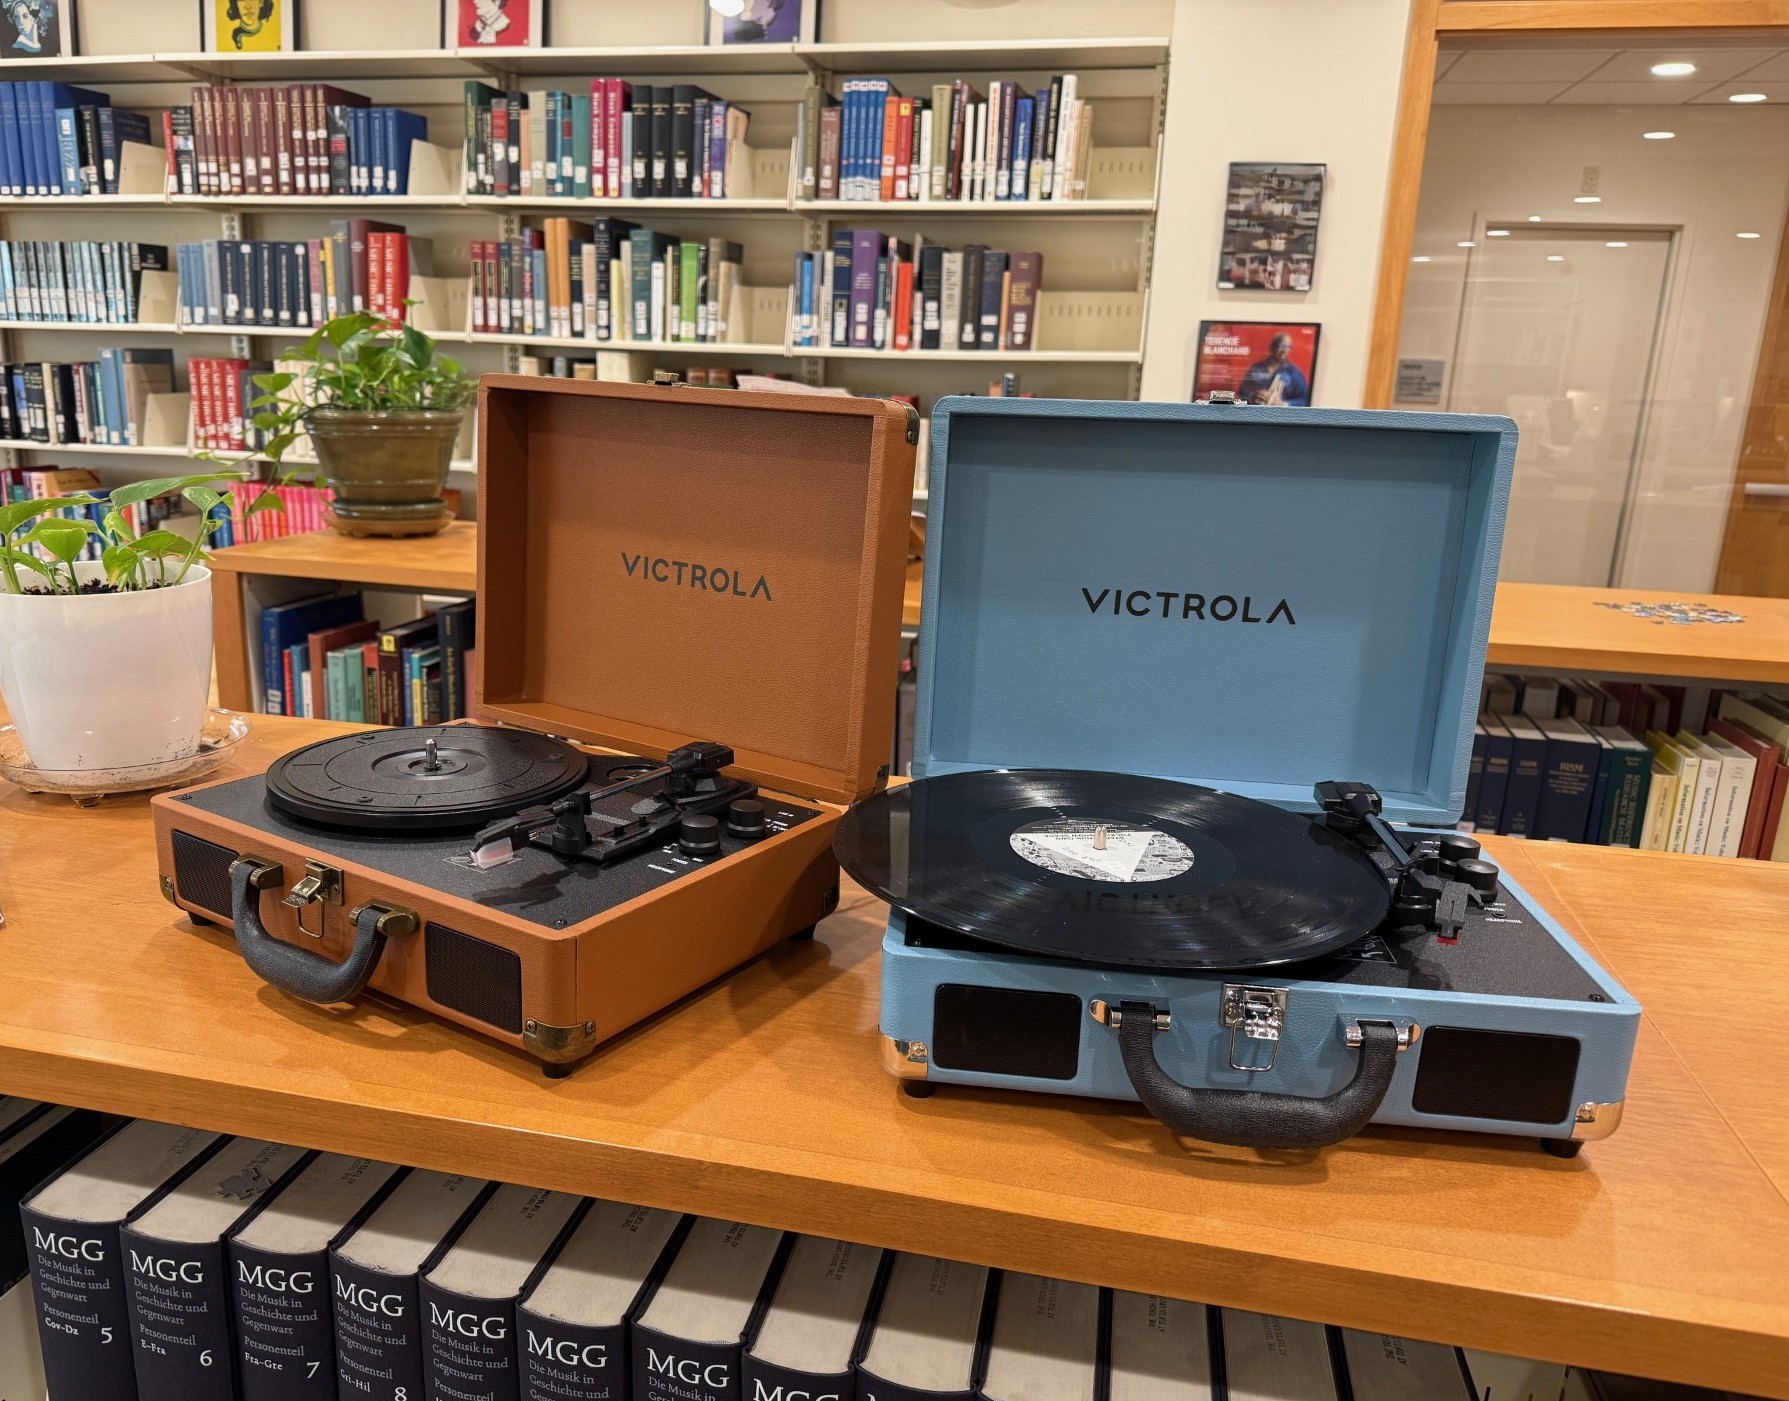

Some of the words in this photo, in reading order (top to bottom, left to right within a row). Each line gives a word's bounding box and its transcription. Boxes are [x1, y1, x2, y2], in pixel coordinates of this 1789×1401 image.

[1202, 345, 1250, 356] BLANCHARD
[1203, 335, 1240, 346] TERENCE
[621, 552, 772, 601] VICTROLA
[1081, 587, 1296, 625] VICTROLA
[33, 1226, 105, 1261] MGG
[38, 1254, 51, 1267] Die
[53, 1261, 82, 1275] Musik
[84, 1266, 96, 1276] in
[130, 1249, 204, 1283] MGG
[237, 1259, 314, 1294] MGG
[39, 1269, 86, 1289] Geschichte
[88, 1279, 111, 1290] und
[134, 1277, 148, 1290] Die
[150, 1282, 180, 1297] Musik
[181, 1289, 193, 1298] in
[41, 1282, 88, 1302] Gegenwart
[135, 1291, 183, 1311] Geschichte
[185, 1302, 208, 1313] und
[240, 1287, 256, 1300] Die
[257, 1292, 289, 1307] Musik
[291, 1298, 303, 1308] in
[335, 1273, 405, 1317] MGG
[43, 1302, 100, 1324] Personenteil
[137, 1304, 185, 1325] Gegenwart
[241, 1301, 293, 1322] Geschichte
[295, 1310, 318, 1321] und
[337, 1301, 350, 1317] Die
[350, 1309, 379, 1328] Musik
[381, 1321, 393, 1331] in
[429, 1301, 508, 1339] MGG
[101, 1327, 113, 1344] 5
[139, 1323, 197, 1346] Personenteil
[242, 1315, 294, 1335] Gegenwart
[337, 1316, 383, 1343] Geschichte
[384, 1334, 407, 1345] und
[244, 1335, 305, 1357] Personenteil
[338, 1329, 383, 1357] Gegenwart
[431, 1329, 447, 1344] Die
[448, 1336, 480, 1353] Musik
[482, 1344, 494, 1355] in
[526, 1329, 608, 1368] MGG
[200, 1349, 213, 1367] 6
[339, 1349, 393, 1379] Personenteil
[432, 1344, 484, 1368] Geschichte
[485, 1357, 509, 1369] und
[647, 1347, 730, 1388] MGG
[306, 1361, 320, 1379] 7
[433, 1358, 484, 1382] Gegenwart
[529, 1359, 545, 1373] Die
[546, 1366, 580, 1384] Musik
[582, 1374, 595, 1385] in
[394, 1386, 407, 1401] 8
[434, 1377, 494, 1401] Personenteil
[529, 1375, 584, 1398] Geschichte
[585, 1387, 610, 1399] und
[648, 1376, 666, 1390] Die
[668, 1383, 702, 1401] Musik
